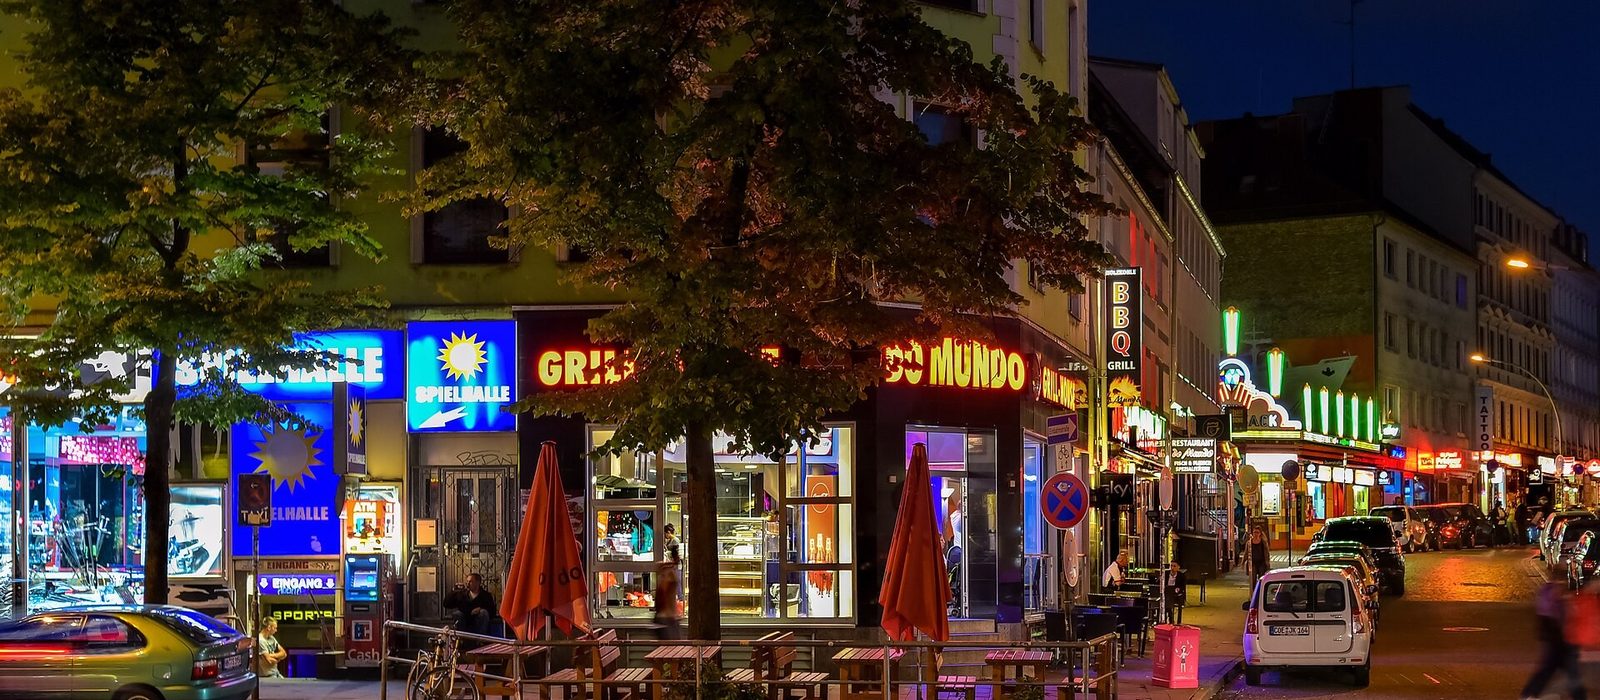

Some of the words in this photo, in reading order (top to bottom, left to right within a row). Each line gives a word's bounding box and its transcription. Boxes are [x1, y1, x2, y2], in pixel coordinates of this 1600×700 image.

[1111, 281, 1131, 357] BBQ
[175, 348, 384, 386] SPIHALLE
[929, 337, 1025, 391] MUNDO
[1107, 361, 1136, 370] GRILL
[415, 386, 510, 403] SPIELHALLE
[1248, 414, 1278, 428] ACK
[1480, 397, 1490, 450] TATTOO
[241, 507, 269, 522] TXI
[271, 506, 329, 520] ELHALLE
[354, 502, 377, 513] ATM
[267, 561, 309, 570] EINGANG
[272, 577, 323, 589] EINGANG
[273, 610, 337, 621] SPORTS
[348, 648, 380, 661] Cash
